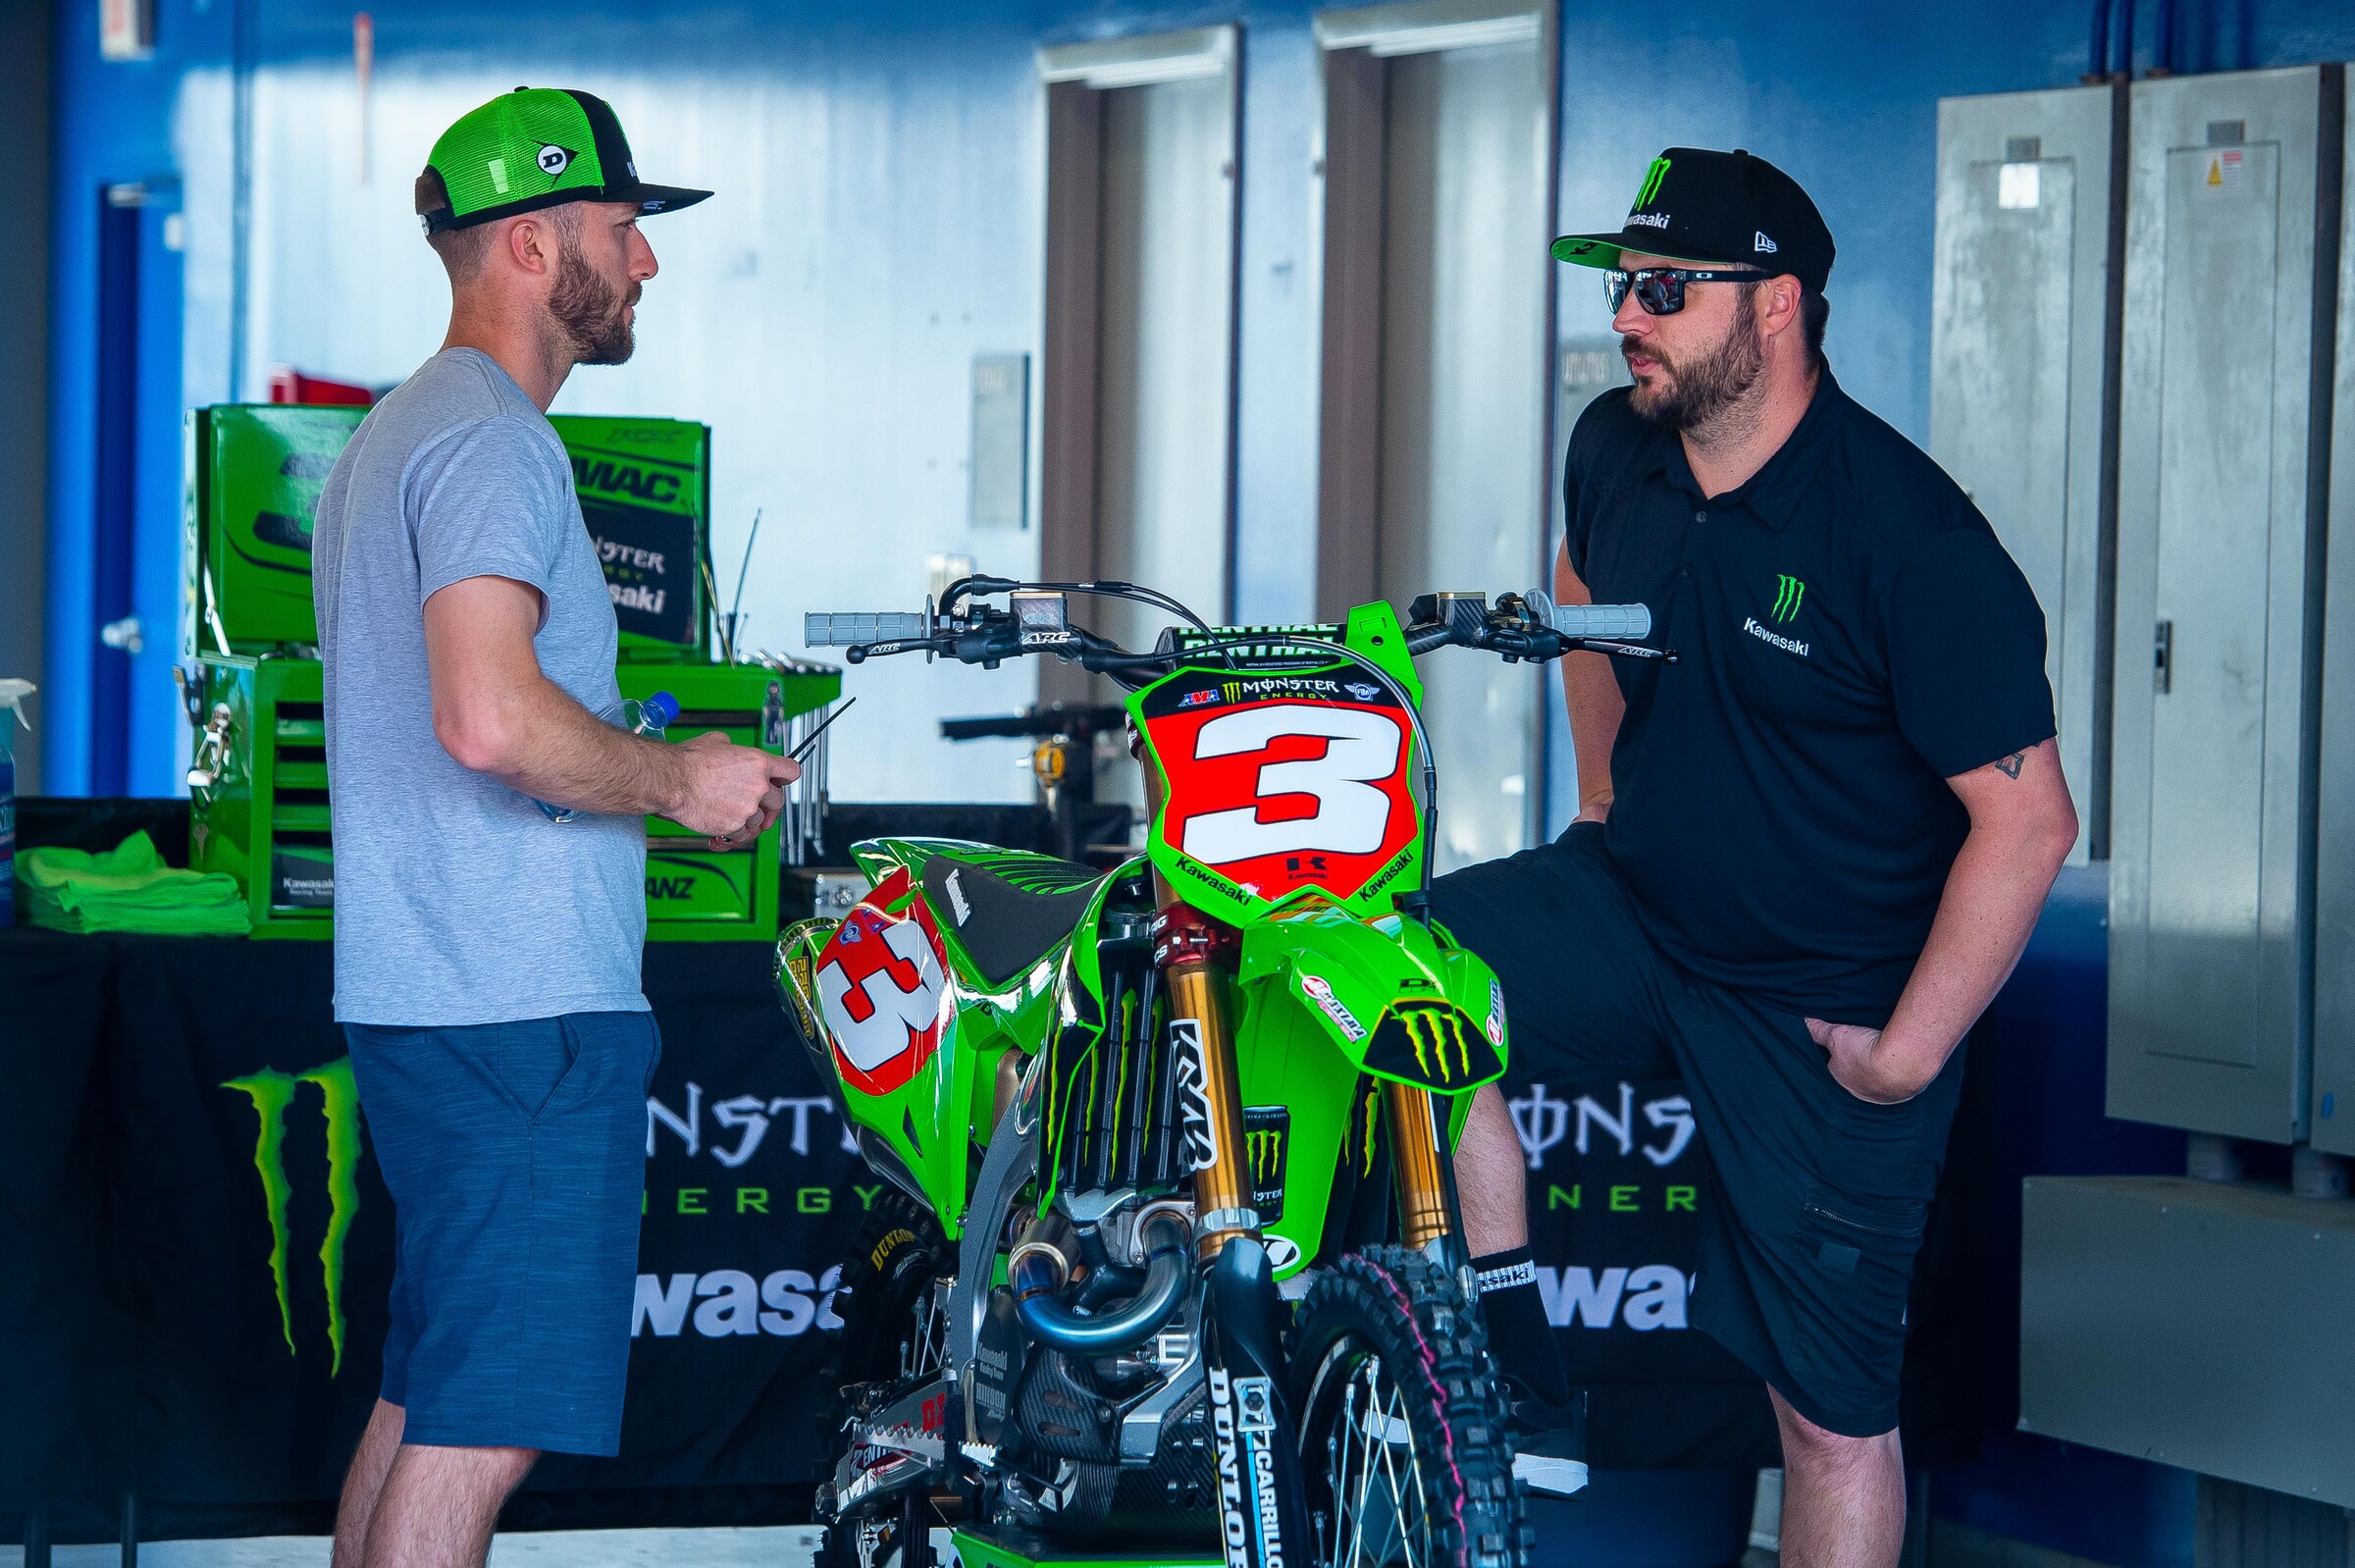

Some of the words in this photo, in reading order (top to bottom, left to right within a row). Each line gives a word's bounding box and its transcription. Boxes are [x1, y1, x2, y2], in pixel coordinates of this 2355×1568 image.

[868, 643, 901, 654] ARC
[1021, 632, 1071, 644] ARC
[1618, 646, 1652, 658] ARC
[1744, 617, 1808, 655] Kawasaki
[1178, 689, 1221, 707] AMA
[1260, 691, 1328, 701] ENERGY
[1181, 704, 1401, 865] 3
[283, 877, 335, 889] Kawasak
[1176, 856, 1253, 907] Kawasaki
[1358, 849, 1415, 903] Kawasaki
[816, 919, 946, 1072] 3
[1547, 1183, 1698, 1213] NER
[870, 1228, 916, 1272] DUNLOP
[1535, 1264, 1697, 1332] wa
